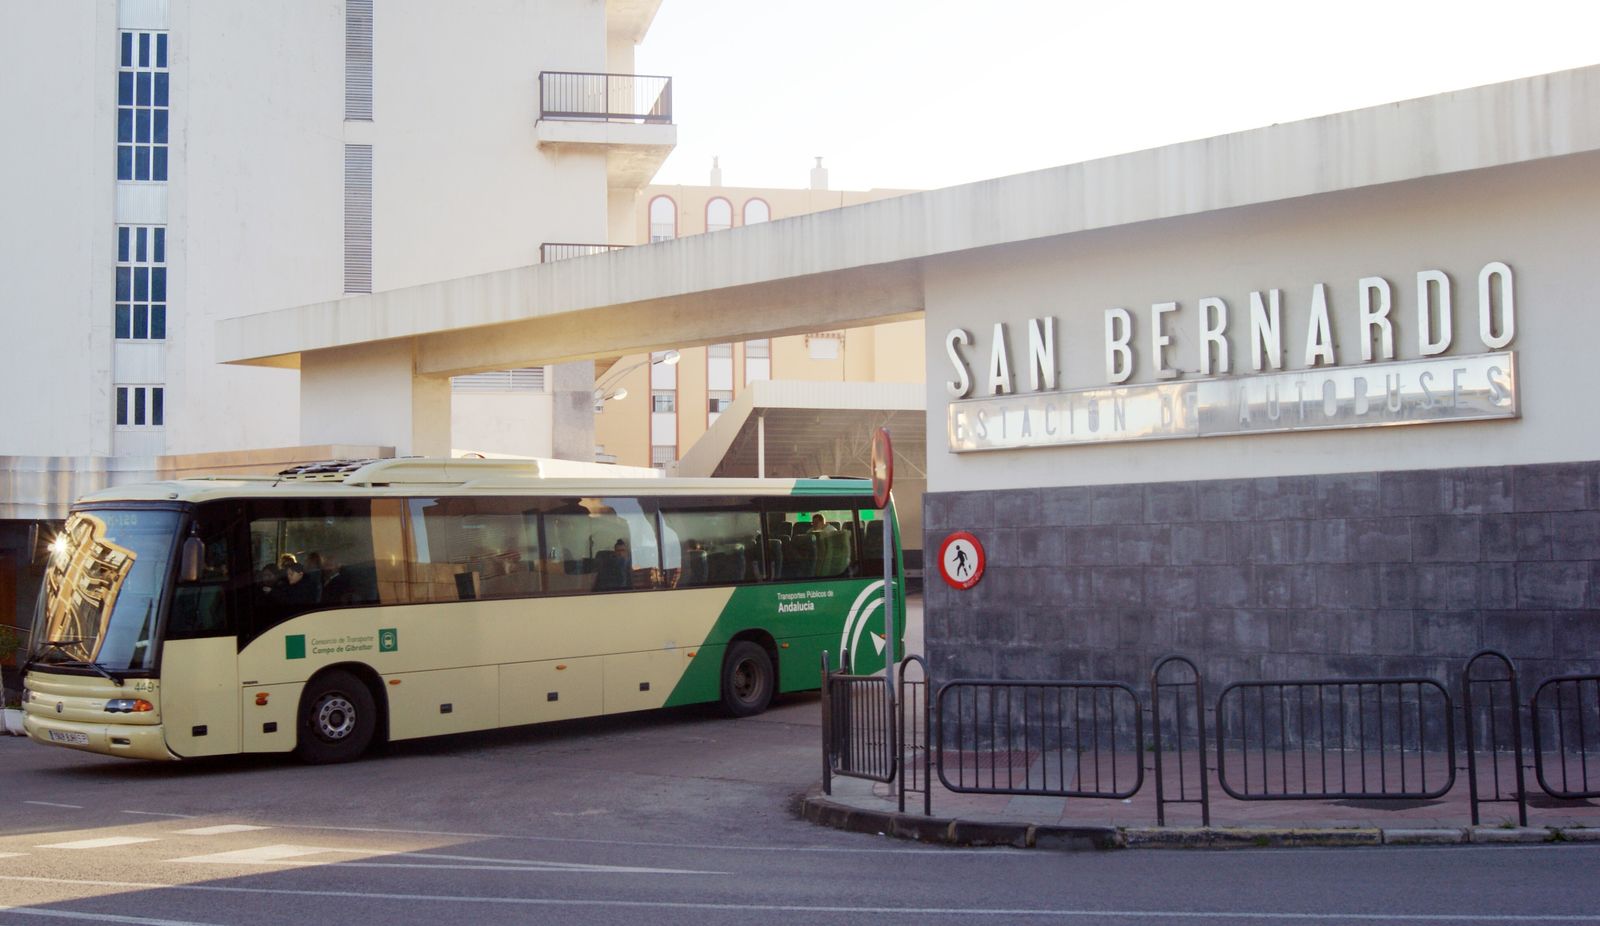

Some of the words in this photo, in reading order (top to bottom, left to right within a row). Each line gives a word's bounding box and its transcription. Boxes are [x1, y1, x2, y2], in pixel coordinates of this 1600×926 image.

[946, 316, 1056, 399] SAN
[1105, 261, 1515, 384] BERNARDO
[1160, 389, 1199, 428] DE
[1239, 366, 1508, 425] AUTOBUSES
[777, 592, 805, 600] Transportes
[312, 646, 335, 655] Campo
[345, 644, 373, 653] Gibraltar
[134, 681, 154, 693] 449
